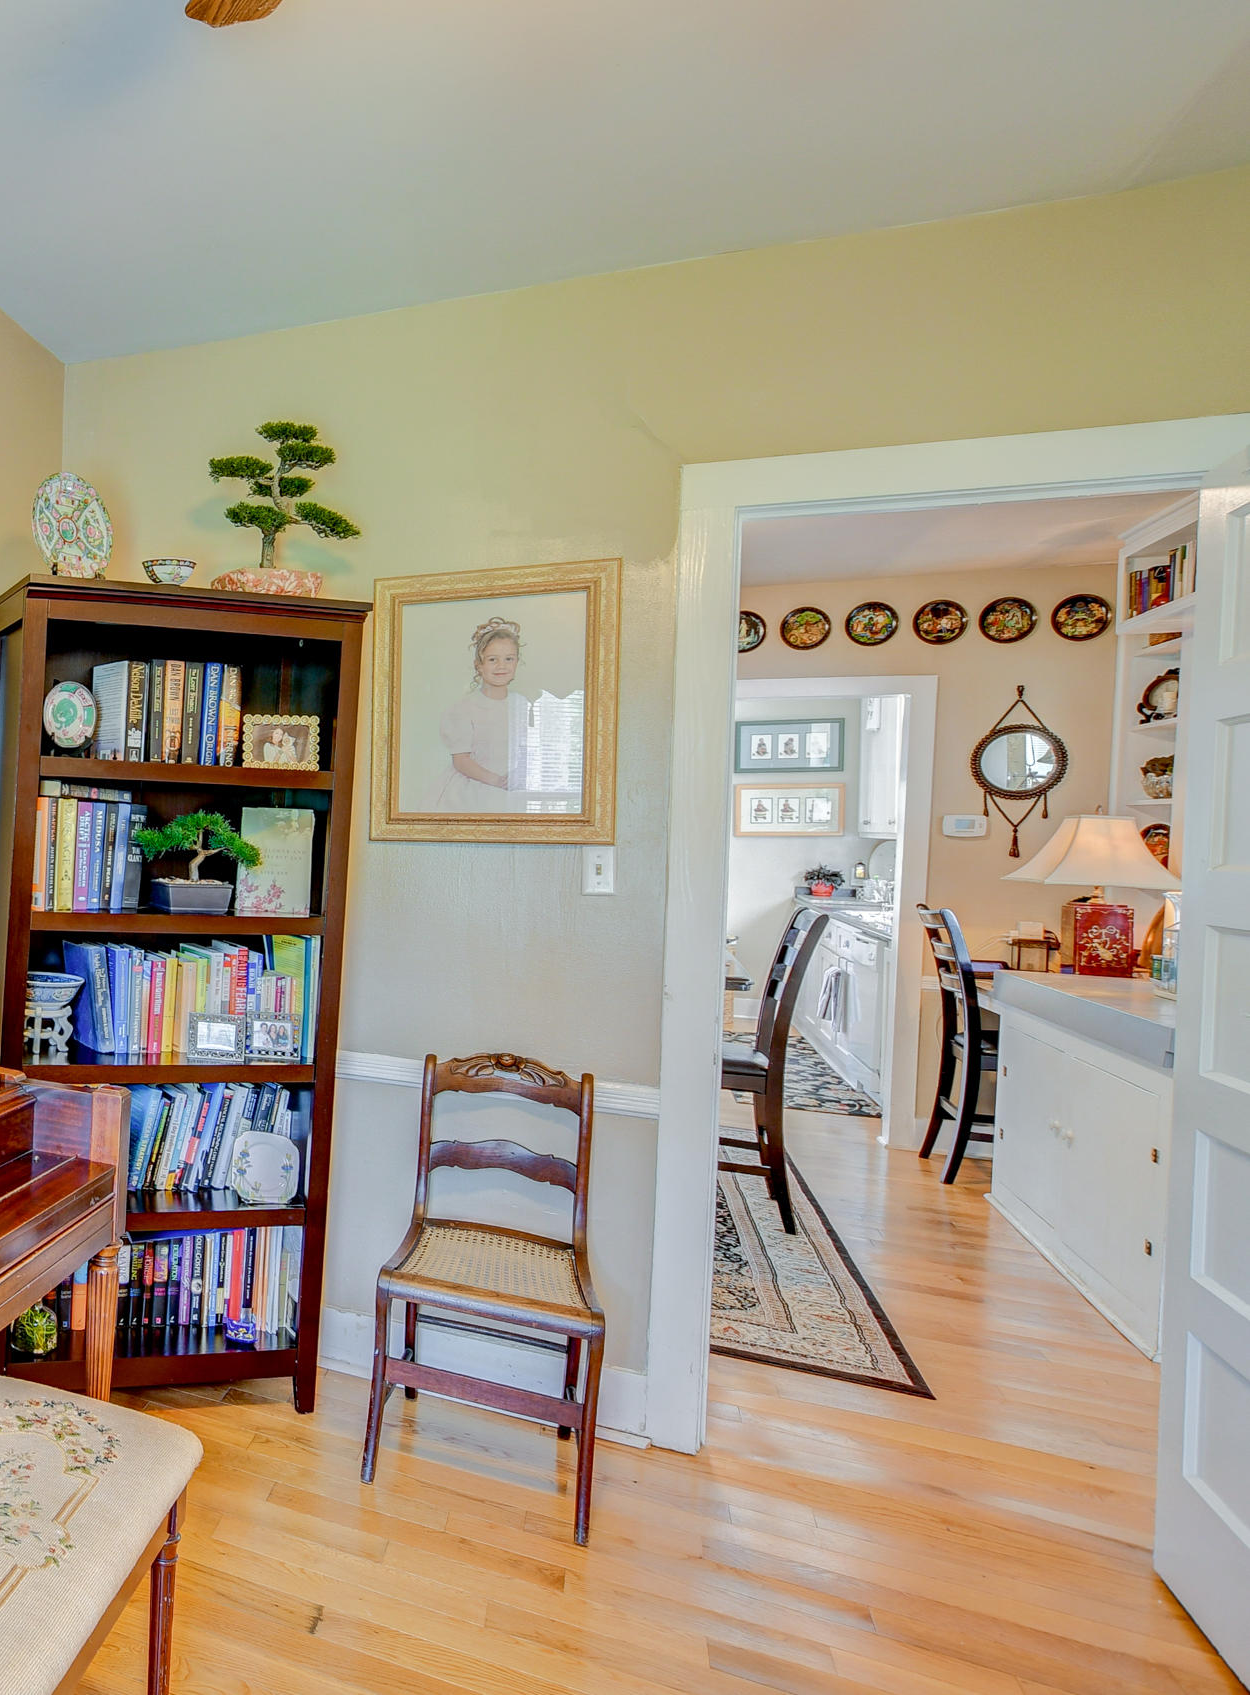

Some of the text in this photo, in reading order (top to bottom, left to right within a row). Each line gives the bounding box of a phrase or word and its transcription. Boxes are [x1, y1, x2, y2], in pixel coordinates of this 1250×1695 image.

[130, 664, 145, 690] Nelson
[168, 678, 181, 701] BROWN
[129, 693, 143, 724] DeMille
[205, 665, 220, 767] DAN BROWN ORIGIN
[224, 726, 238, 767] INFERNO
[94, 811, 103, 853] MEDUSA
[237, 949, 248, 987] LEADING
[136, 1140, 150, 1171] STRATEGY
[118, 1250, 128, 1279] MARK
[194, 1253, 204, 1277] GOSPEL
